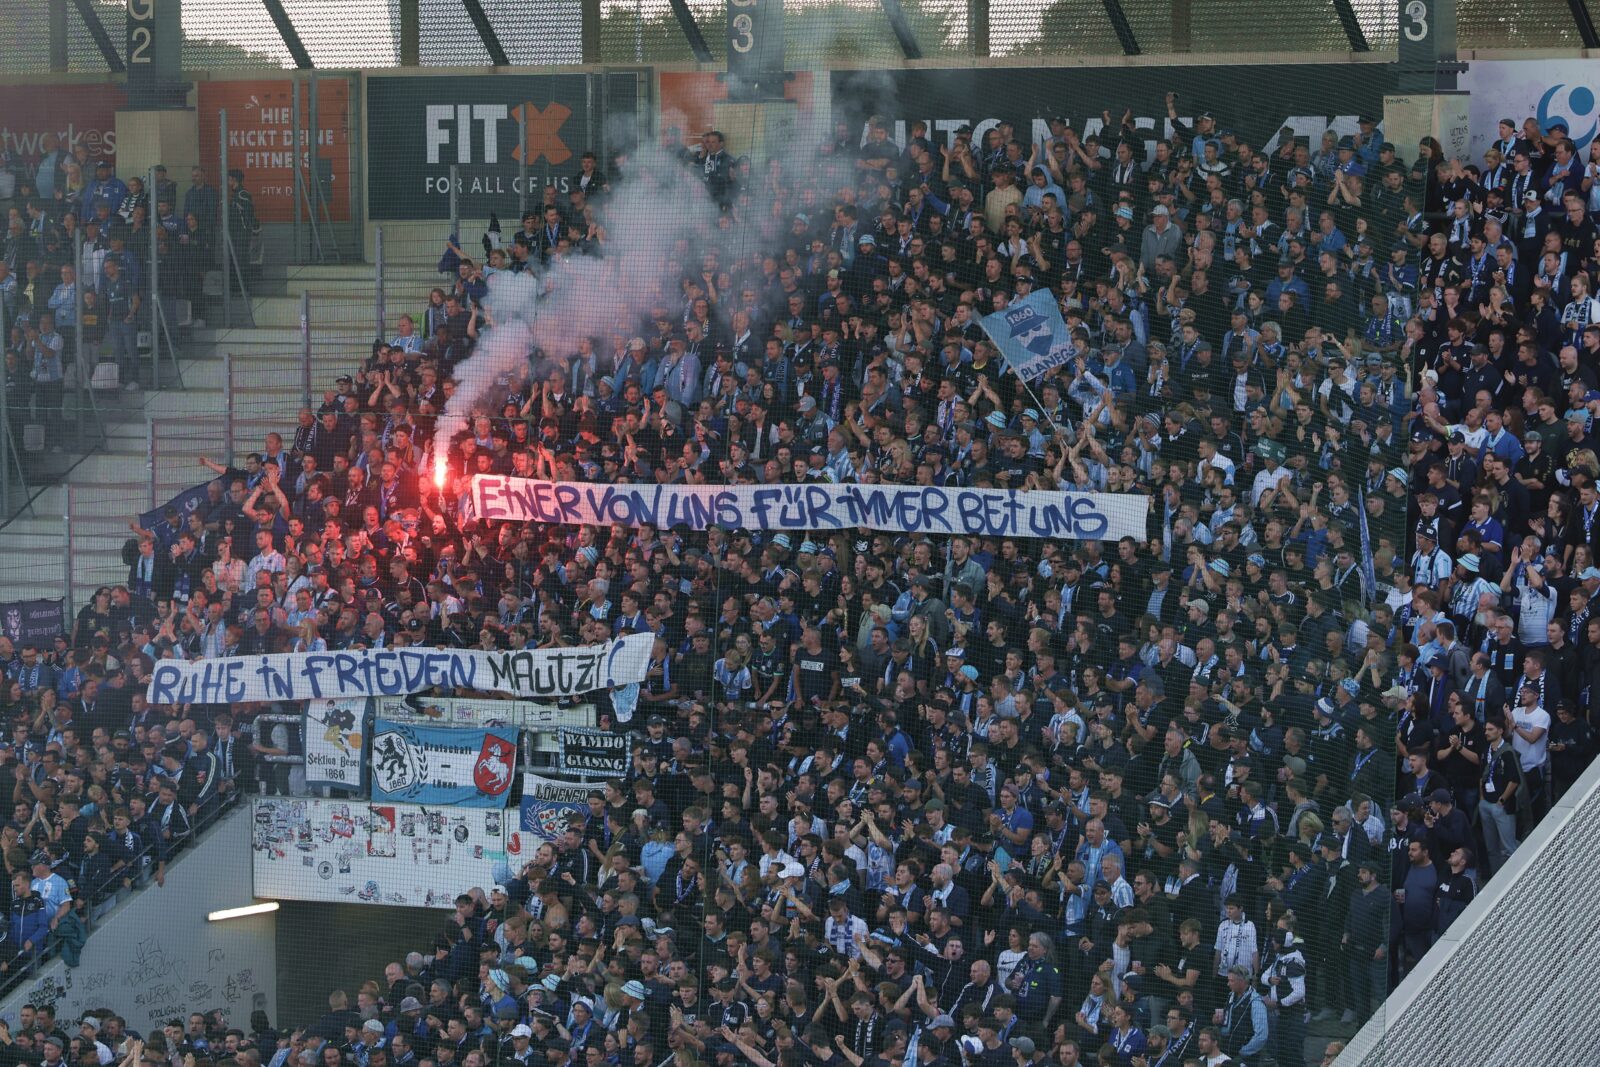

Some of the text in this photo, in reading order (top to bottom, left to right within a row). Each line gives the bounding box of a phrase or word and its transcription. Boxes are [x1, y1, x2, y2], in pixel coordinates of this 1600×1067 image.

[1404, 0, 1428, 41] 3
[732, 14, 754, 53] 3
[131, 27, 151, 63] 2
[261, 108, 294, 124] HIE
[229, 130, 277, 147] KICKT
[245, 151, 312, 169] FITNES
[426, 176, 569, 194] FOR ALL OF US
[1007, 307, 1034, 325] 1860
[586, 484, 664, 527] VON
[666, 491, 743, 529] UNS
[750, 485, 843, 530] FÜR
[1029, 495, 1108, 540] UNS
[564, 733, 625, 749] WAMBO
[566, 757, 624, 770] GIASING
[324, 768, 345, 781] 1860
[389, 776, 406, 789] 1860
[534, 783, 592, 804] LÖWENFA
